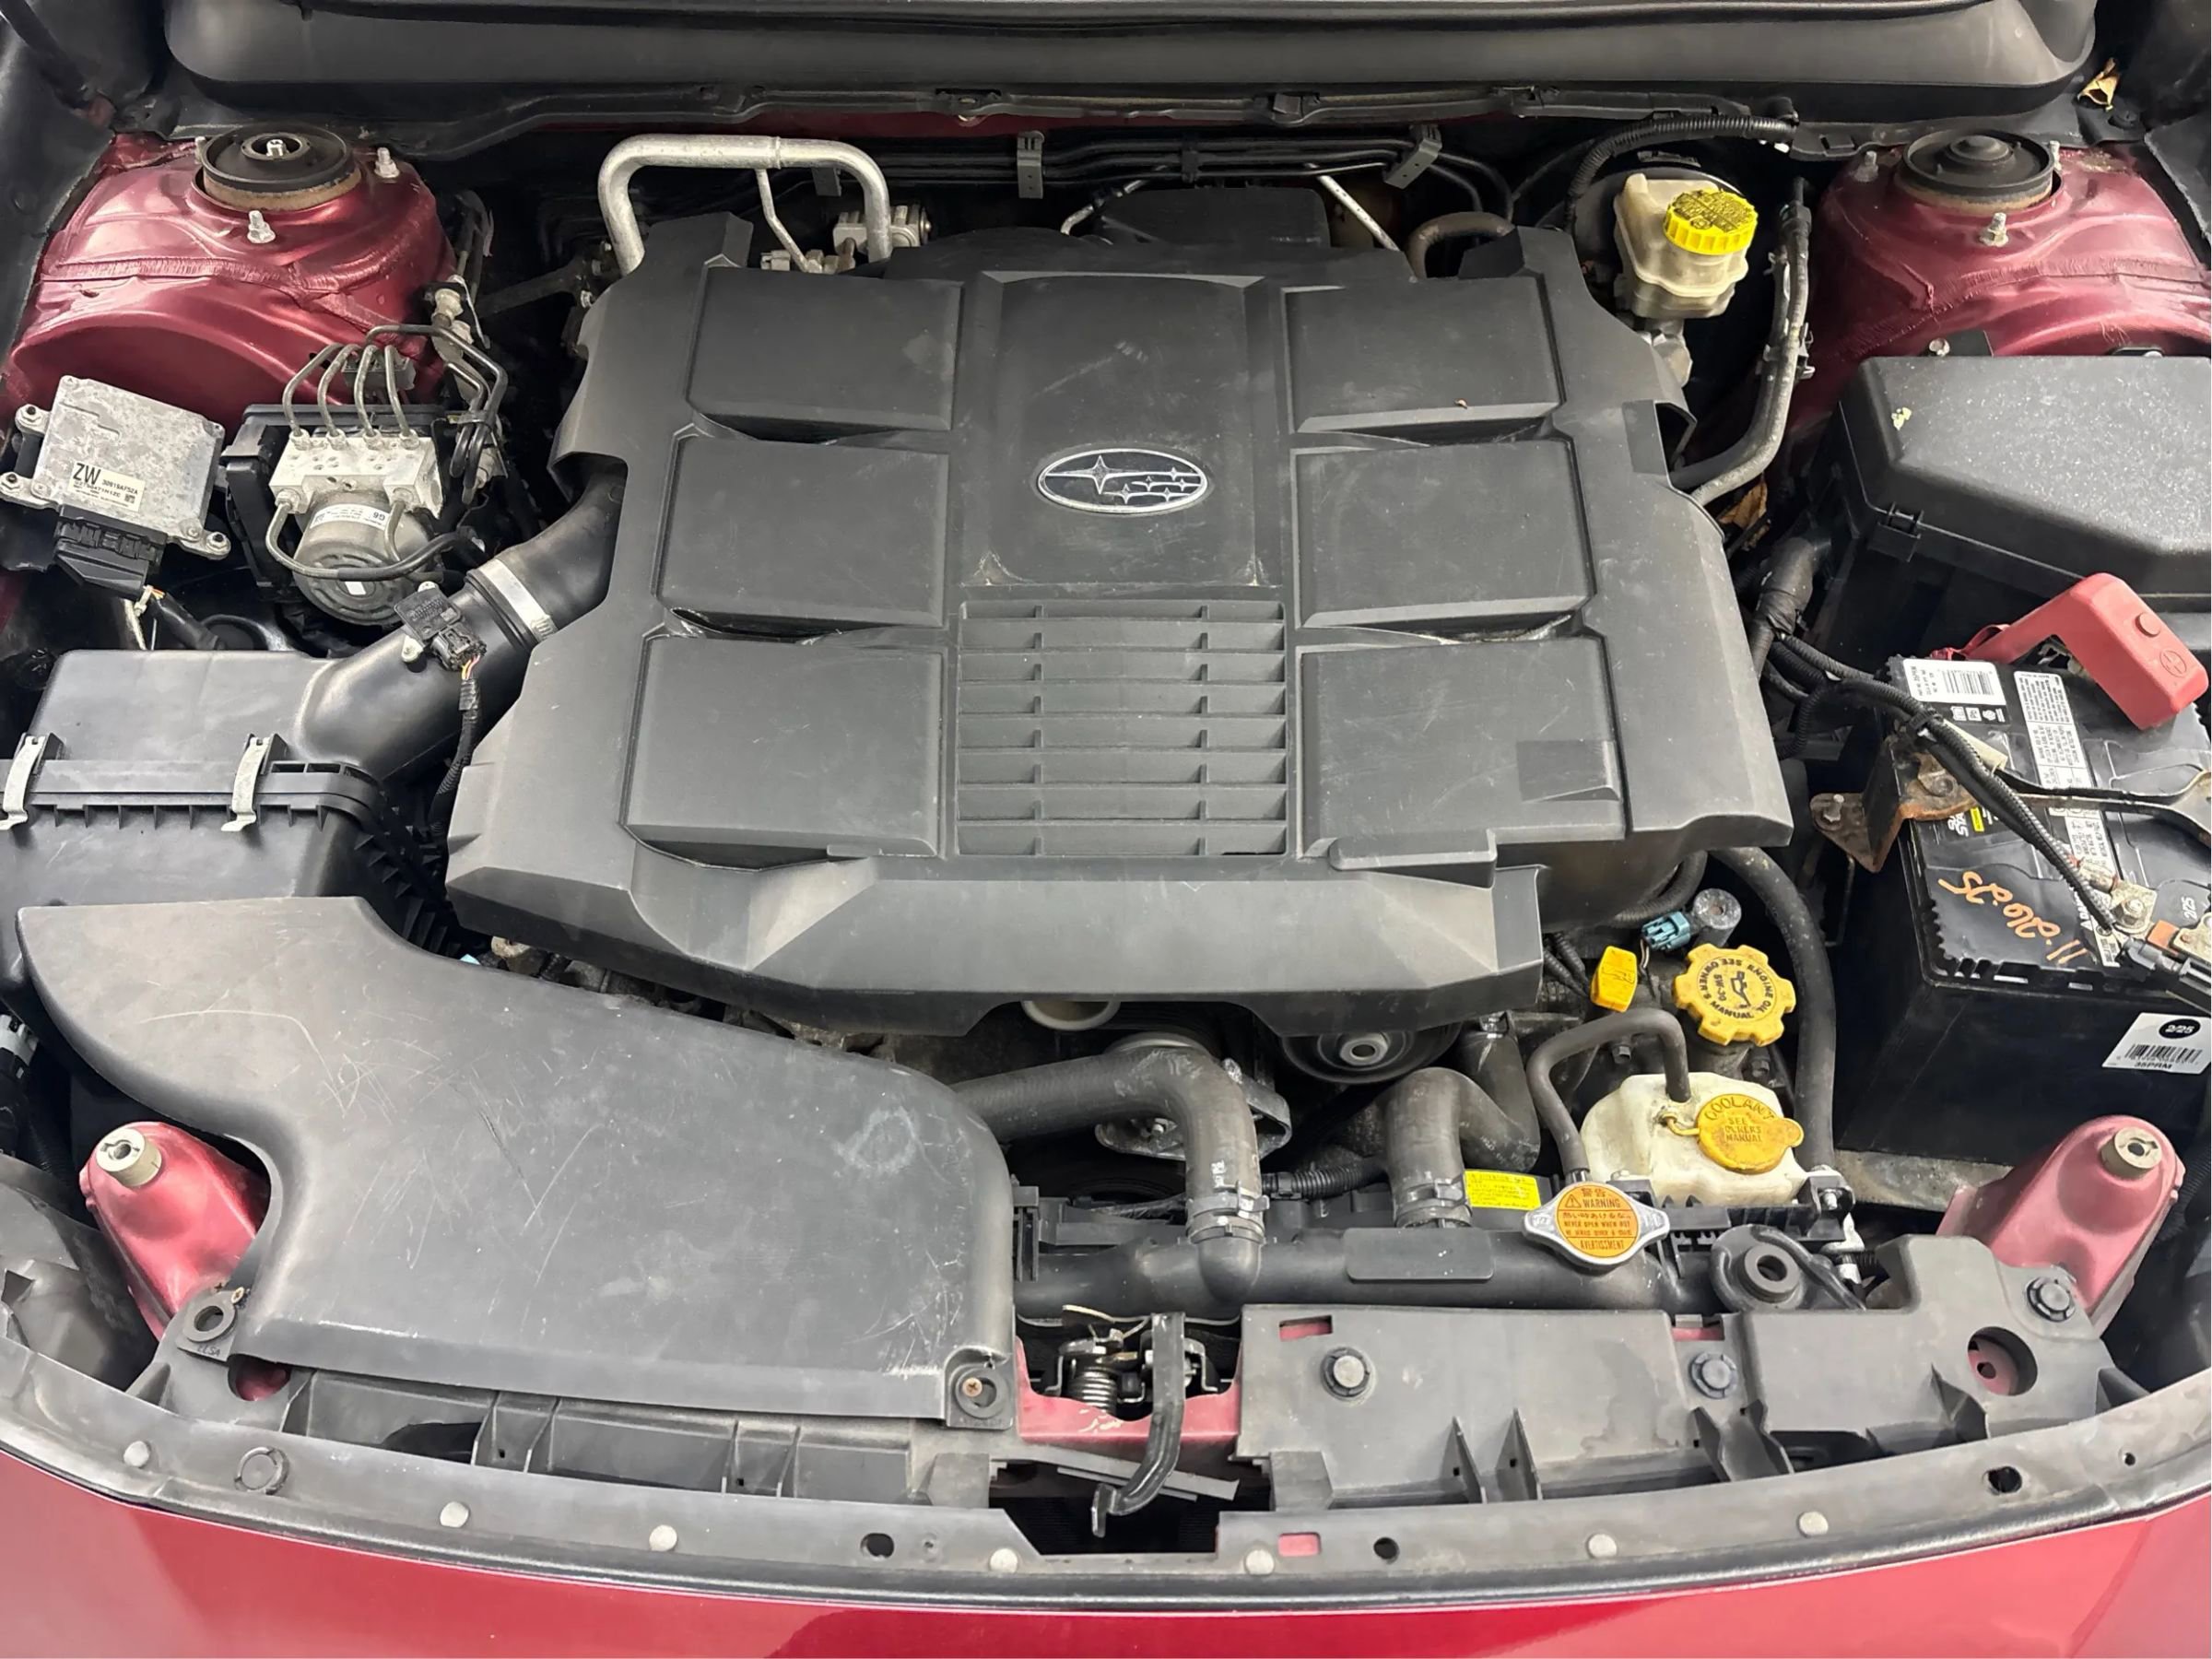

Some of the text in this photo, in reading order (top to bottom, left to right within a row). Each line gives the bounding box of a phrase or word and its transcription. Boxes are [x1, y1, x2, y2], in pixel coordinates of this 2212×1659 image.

[73, 462, 101, 485] ZW
[1722, 958, 1743, 967] SEE
[1713, 973, 1727, 1002] 5W-30
[1747, 964, 1774, 1013] ENGINE OIL
[1710, 1000, 1755, 1019] MANUAL
[2164, 1024, 2195, 1034] 2/25
[1704, 1096, 1775, 1121] COOLANT
[1727, 1116, 1748, 1125] SEE
[1724, 1134, 1762, 1143] MANUAL
[1583, 1198, 1621, 1208] WARNING
